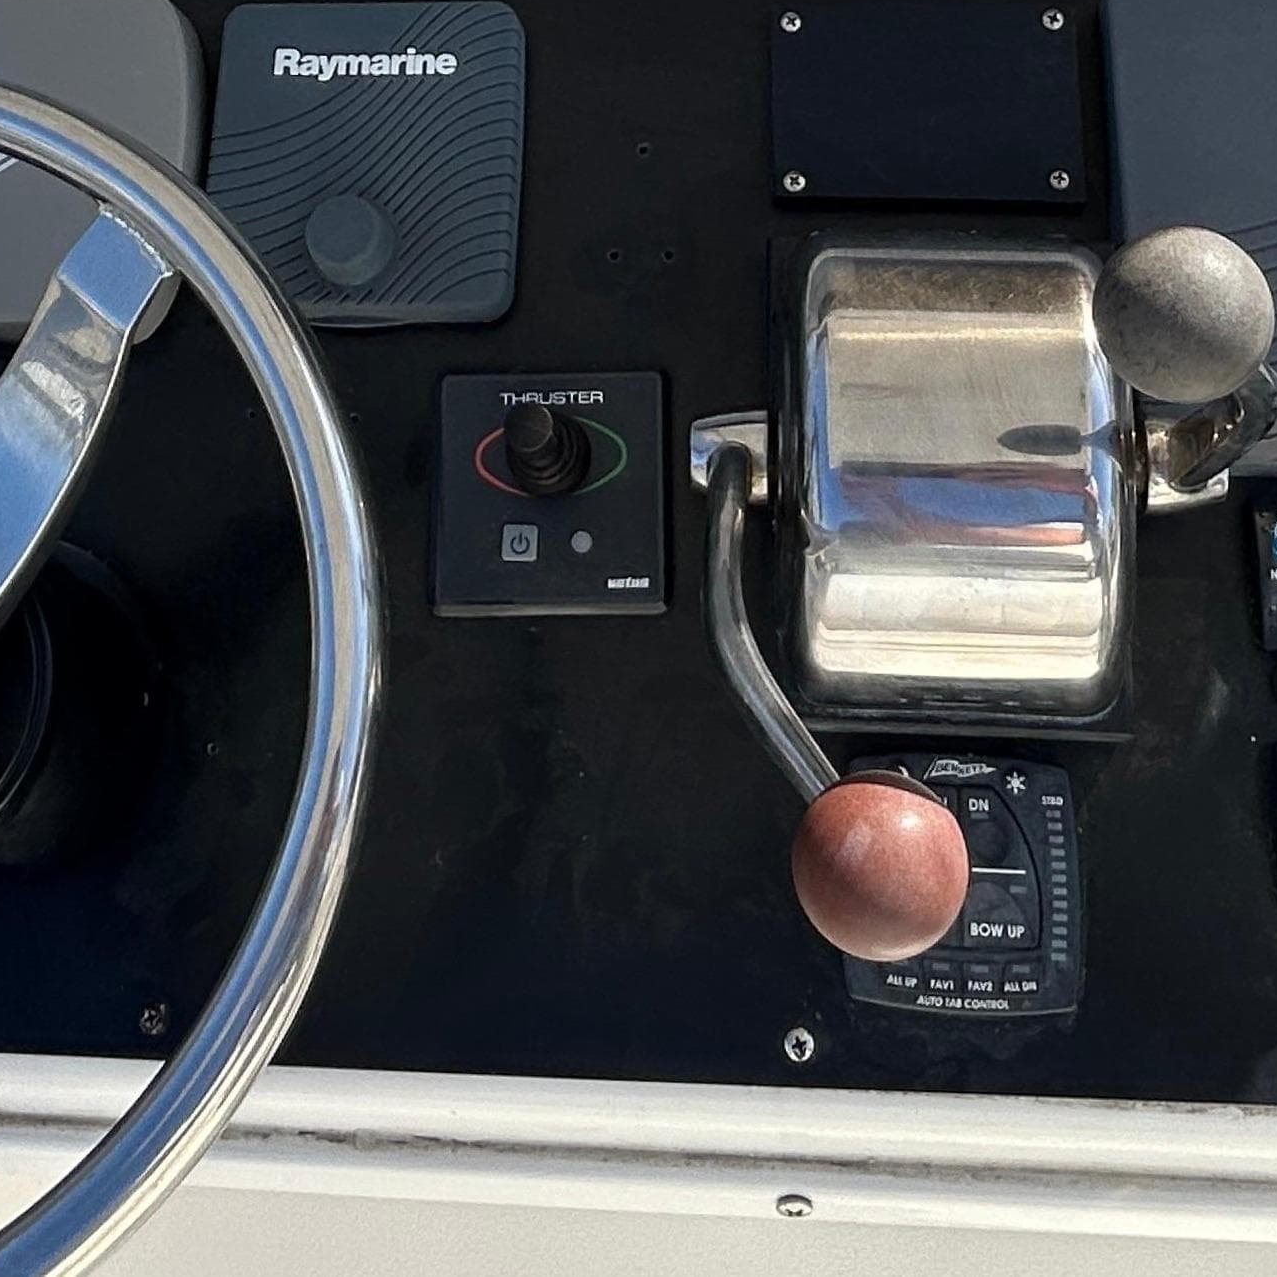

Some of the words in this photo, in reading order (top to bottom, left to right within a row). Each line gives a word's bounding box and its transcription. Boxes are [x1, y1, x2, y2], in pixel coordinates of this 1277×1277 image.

[273, 47, 458, 82] Raymarine
[499, 390, 604, 406] THRUSTER
[968, 798, 990, 811] DN
[969, 922, 1004, 938] BOW
[1007, 924, 1025, 939] UP
[886, 974, 903, 986] ALL
[904, 976, 918, 988] UP
[930, 979, 954, 991] FAV1
[967, 980, 994, 992] FAV2
[1003, 981, 1020, 992] ALL
[916, 995, 943, 1007] AUTO
[944, 997, 963, 1008] TAB
[963, 998, 1010, 1010] CONTROL
